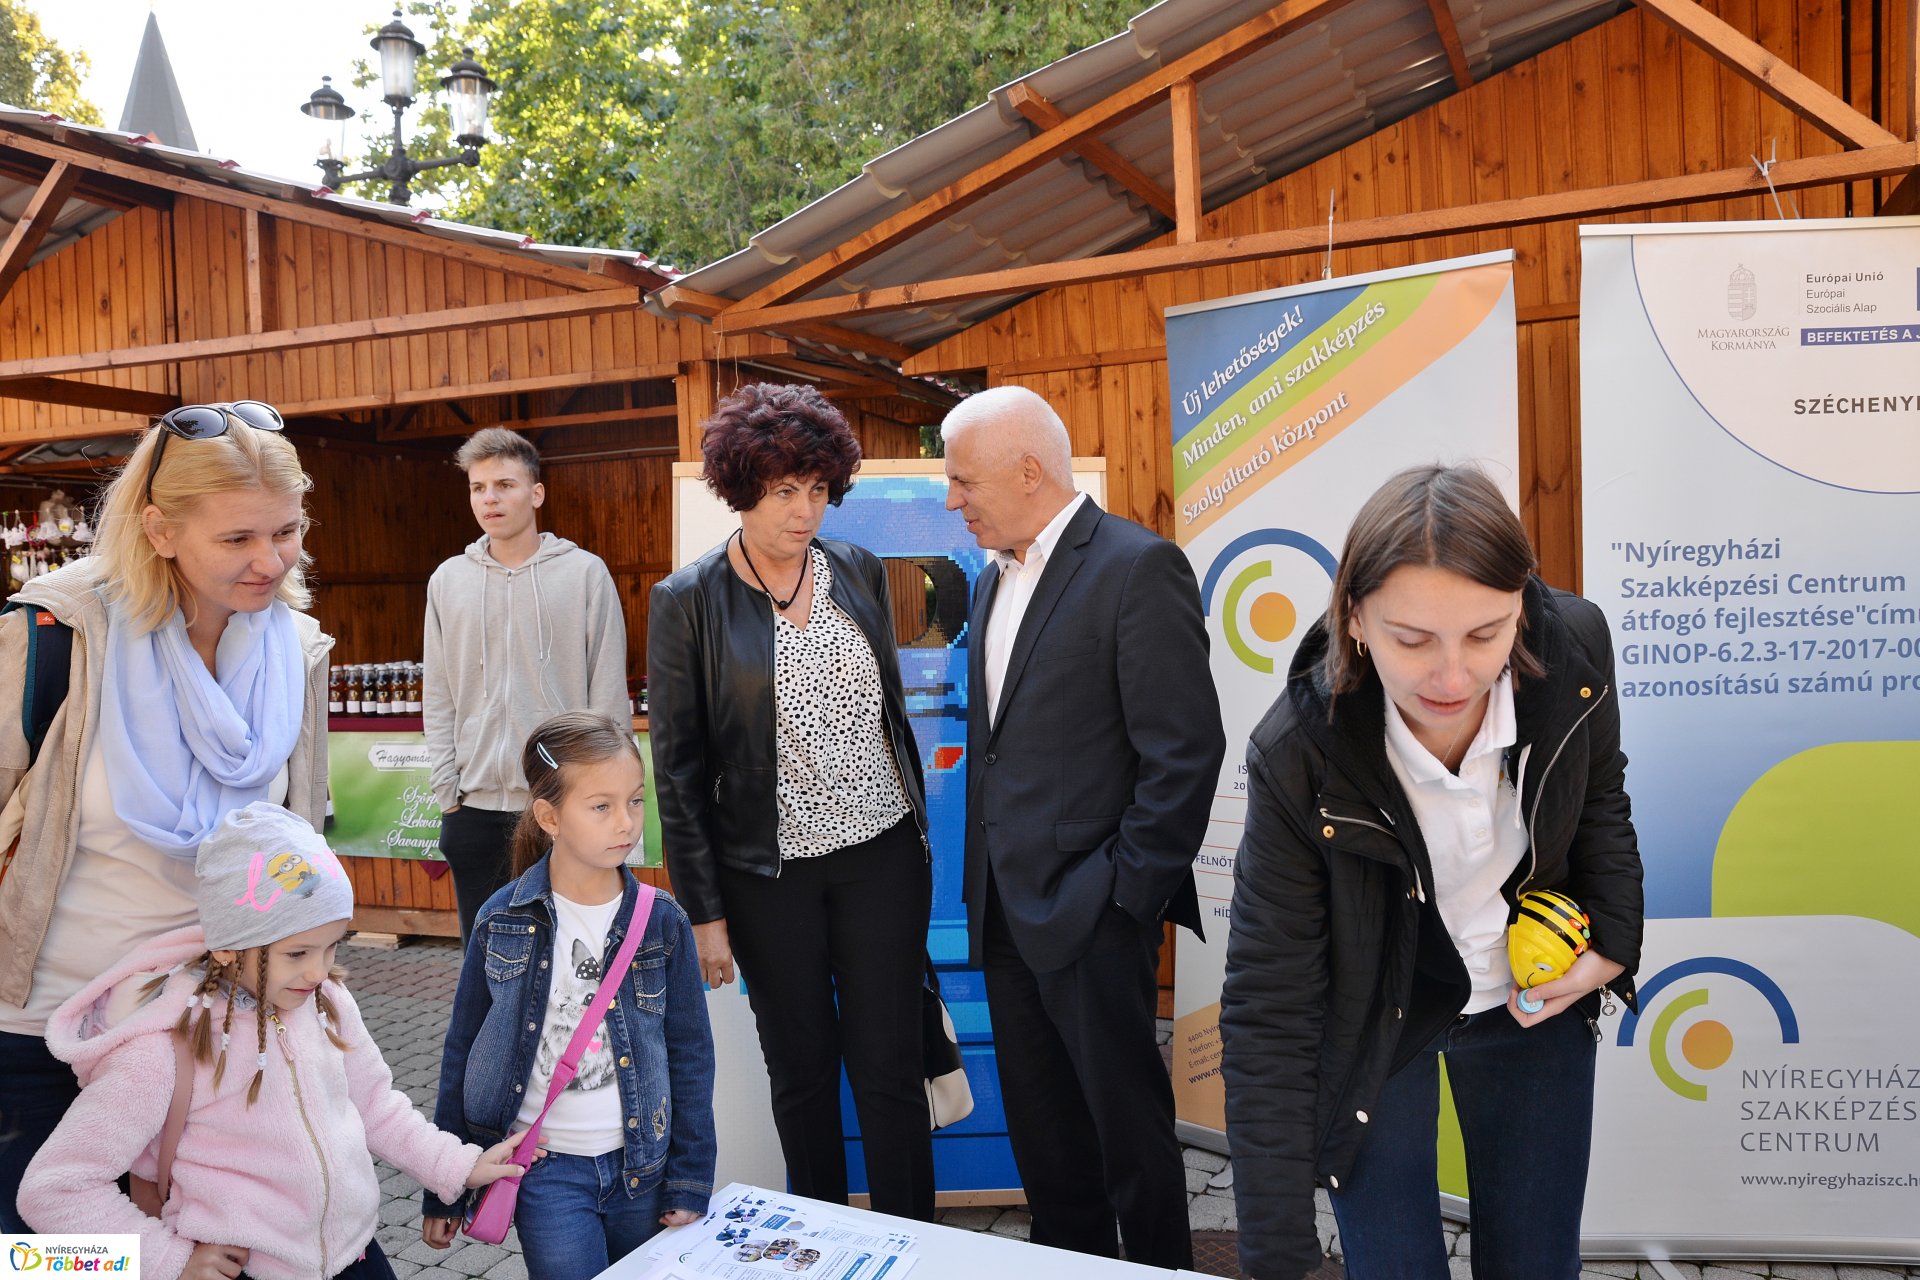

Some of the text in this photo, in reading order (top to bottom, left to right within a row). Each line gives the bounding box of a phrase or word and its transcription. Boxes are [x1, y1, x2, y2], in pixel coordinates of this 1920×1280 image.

[1806, 271, 1884, 284] Európai Unió
[1806, 289, 1846, 300] Európai
[1806, 302, 1877, 314] Szociális Alap
[1697, 326, 1790, 339] MAGYARORSZÁG
[1807, 328, 1898, 343] BEFEKTETÉS
[1902, 328, 1912, 340] A
[1711, 339, 1777, 351] KORMÁNYA
[1181, 304, 1304, 416] Új lehetőségek!
[1181, 301, 1386, 470] Minden, ami szakképzés
[1182, 391, 1349, 525] Szolgáltató központ
[1611, 537, 1781, 568] "Nyíregyházi
[1621, 573, 1906, 602] Szakképzési Centrum
[1621, 603, 1920, 636] átfogó fejlesztése"cím
[1621, 672, 1779, 697] azonosítású
[1787, 670, 1872, 693] számú
[1188, 1031, 1203, 1044] 4400
[1742, 1064, 1920, 1089] NYÍREGYHÁZ
[1740, 1132, 1879, 1152] CENTRUM
[1740, 1173, 1920, 1190] www.nyiregyhaziszc.h
